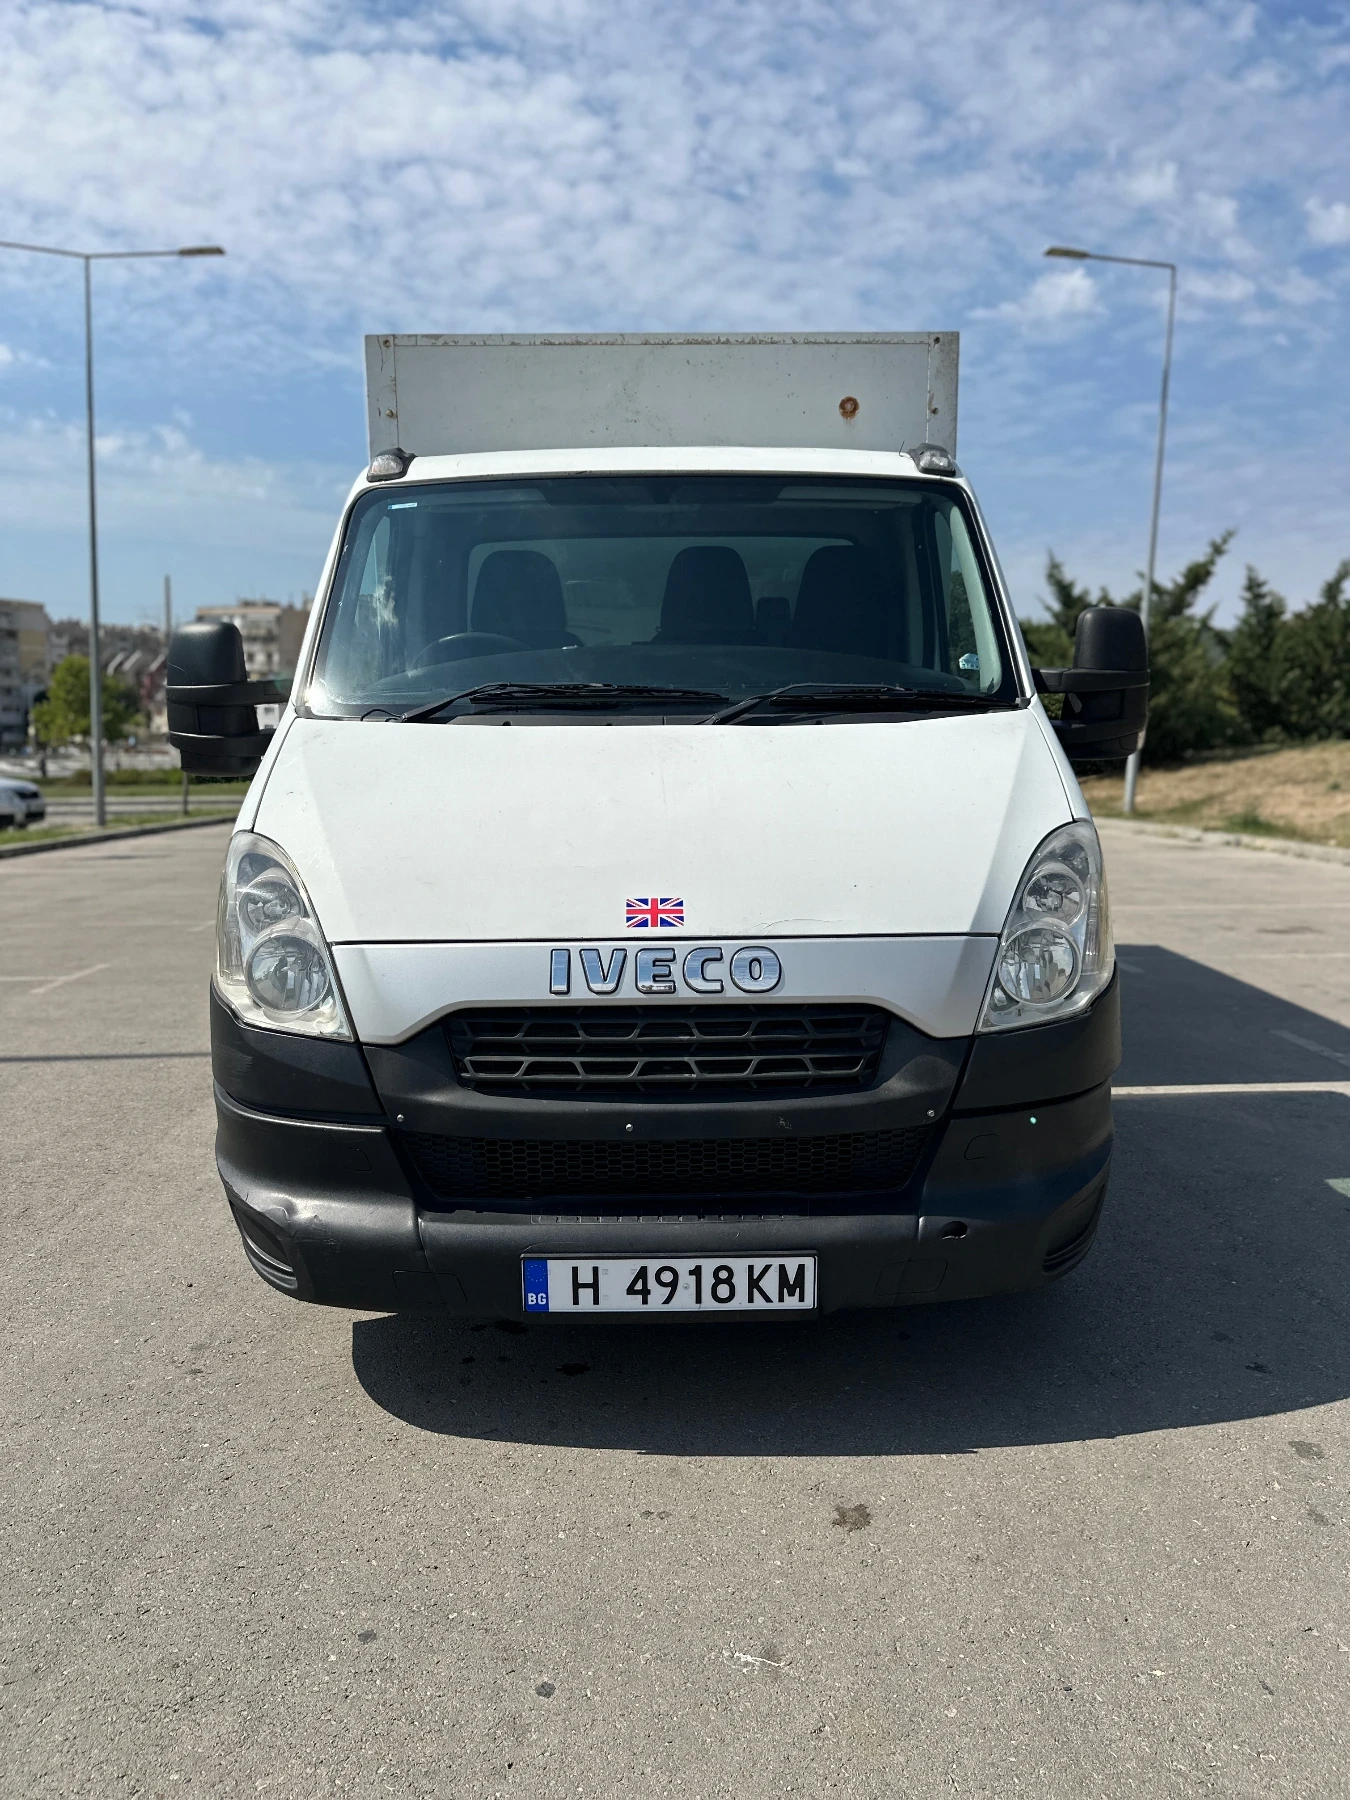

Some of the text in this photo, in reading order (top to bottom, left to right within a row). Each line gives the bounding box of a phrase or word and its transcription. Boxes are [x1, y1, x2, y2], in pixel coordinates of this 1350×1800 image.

[550, 946, 782, 994] IVECO
[527, 1293, 547, 1305] BG
[572, 1266, 600, 1306] H
